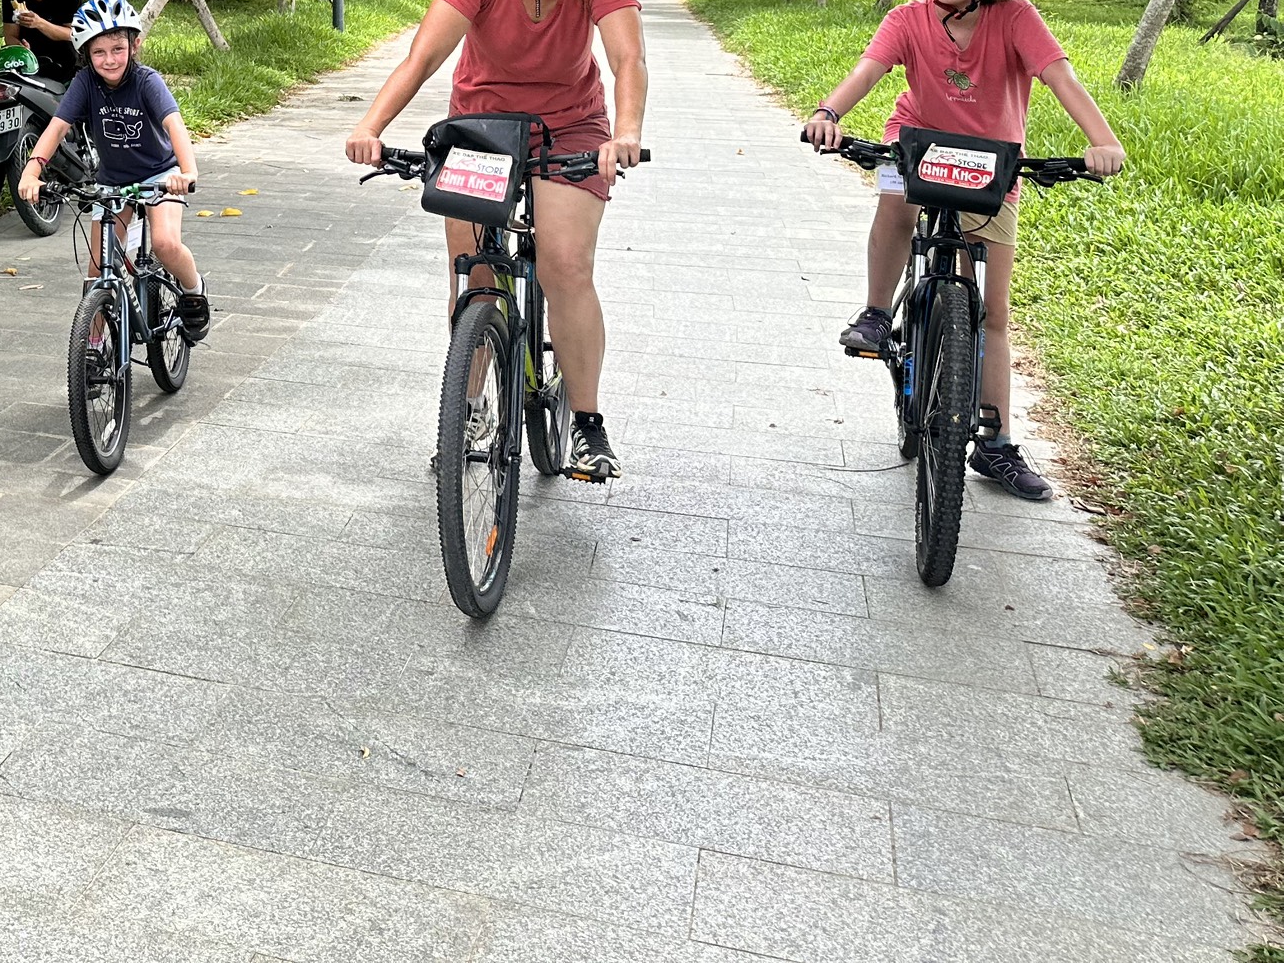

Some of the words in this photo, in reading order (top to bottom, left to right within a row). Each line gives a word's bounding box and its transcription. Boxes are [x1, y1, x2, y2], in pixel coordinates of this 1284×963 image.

[4, 59, 25, 69] Grab
[476, 163, 504, 175] STORE
[958, 158, 988, 170] STORE
[921, 163, 948, 178] ANH
[951, 168, 991, 184] KHOA
[440, 169, 465, 187] ANH
[467, 173, 505, 194] KHOA
